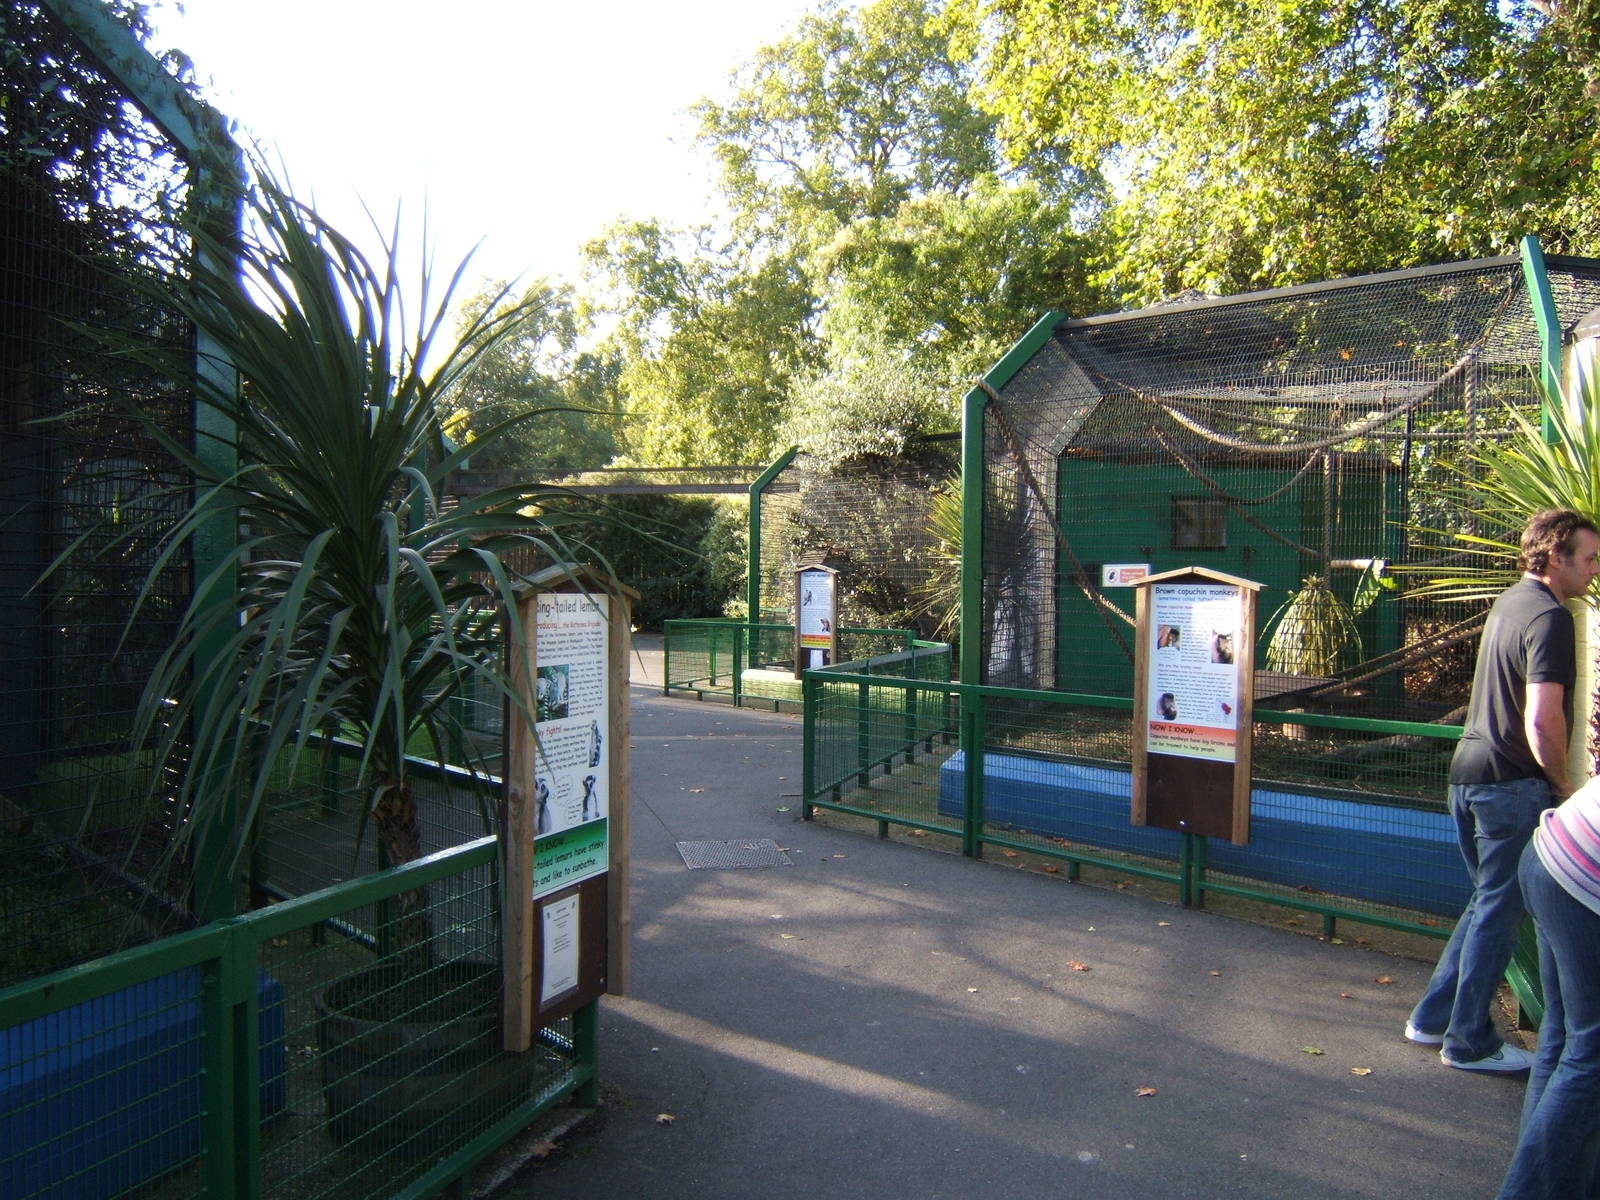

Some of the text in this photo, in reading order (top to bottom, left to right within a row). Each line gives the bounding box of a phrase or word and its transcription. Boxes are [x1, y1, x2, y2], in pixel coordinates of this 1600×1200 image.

[1177, 588, 1207, 596] capuchin
[1209, 588, 1239, 597] monkeys
[1150, 724, 1166, 732] NOW
[1168, 725, 1173, 733] I
[555, 850, 573, 864] lemurs
[574, 847, 587, 856] have
[588, 839, 605, 852] stinky
[540, 874, 551, 885] and
[553, 870, 563, 881] like
[564, 866, 571, 876] to
[572, 857, 598, 873] sunbathe.
